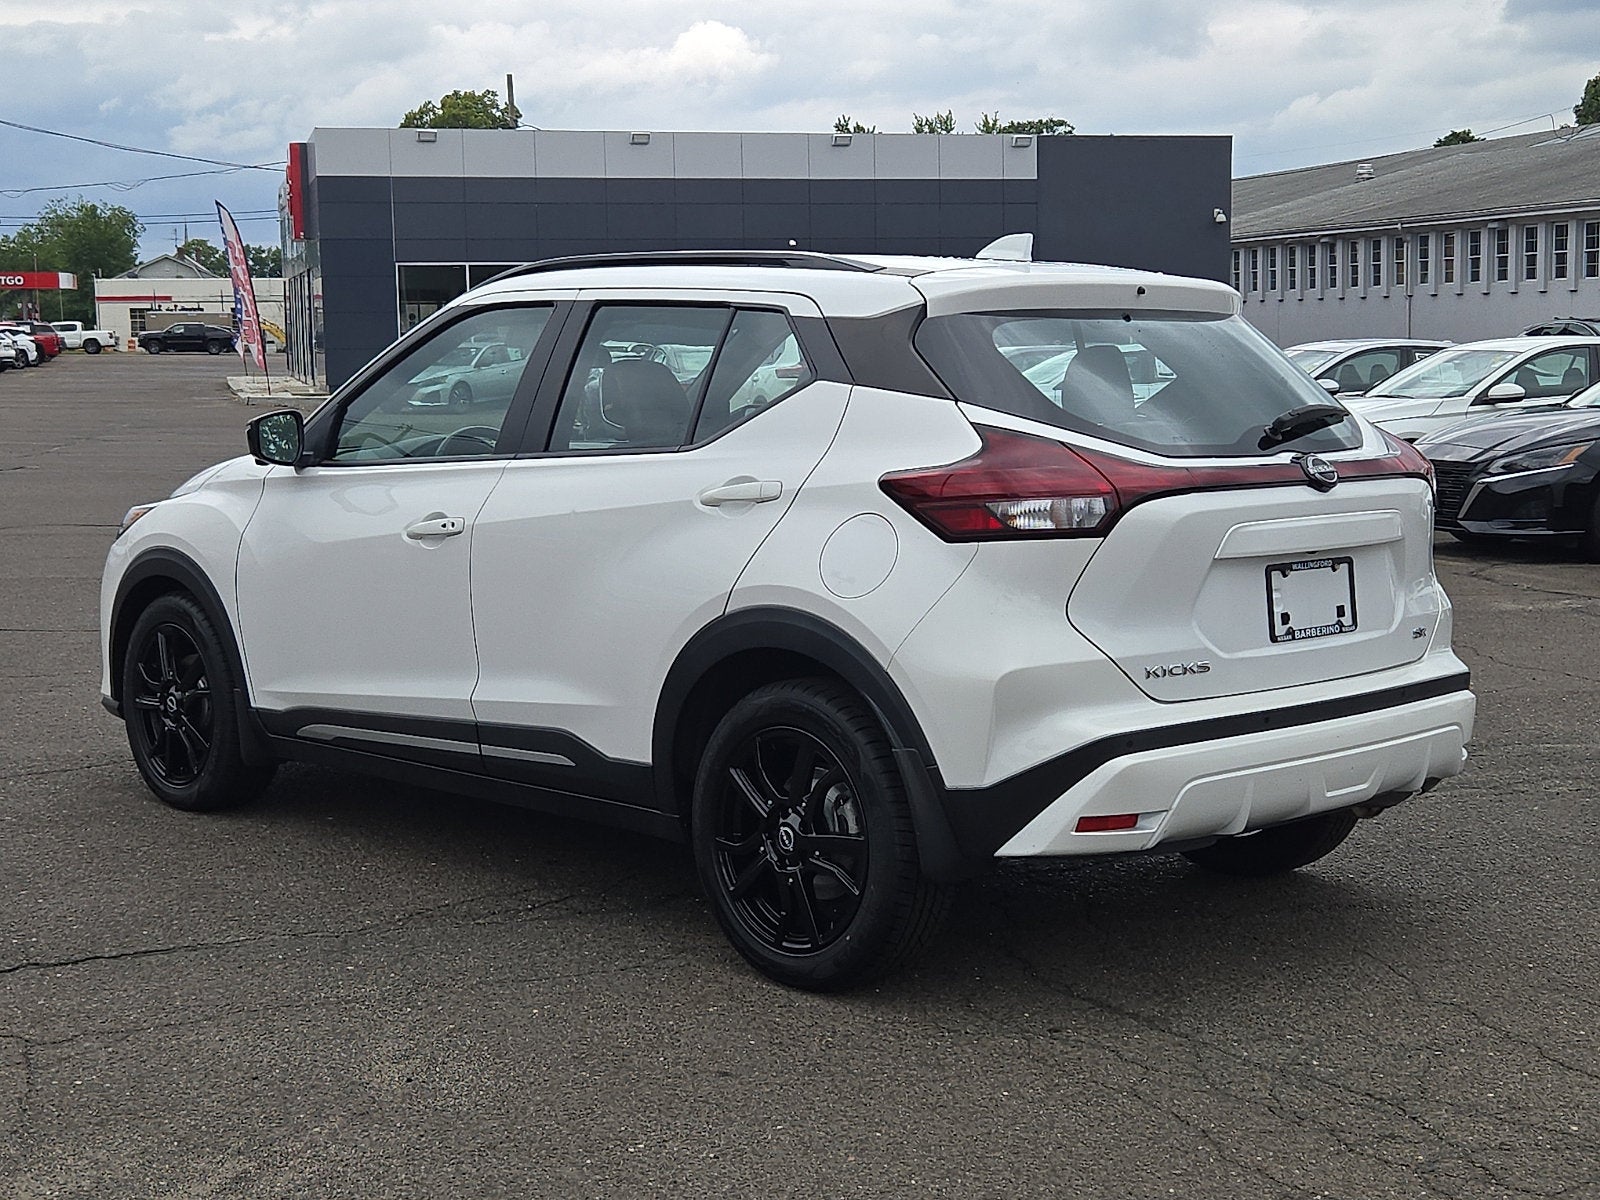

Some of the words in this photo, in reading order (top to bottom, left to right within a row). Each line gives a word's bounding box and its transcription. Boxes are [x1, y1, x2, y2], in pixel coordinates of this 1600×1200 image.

[1291, 559, 1333, 570] WALLINGFORD
[1294, 625, 1340, 640] BARBERINO
[1144, 660, 1211, 680] KICKS
